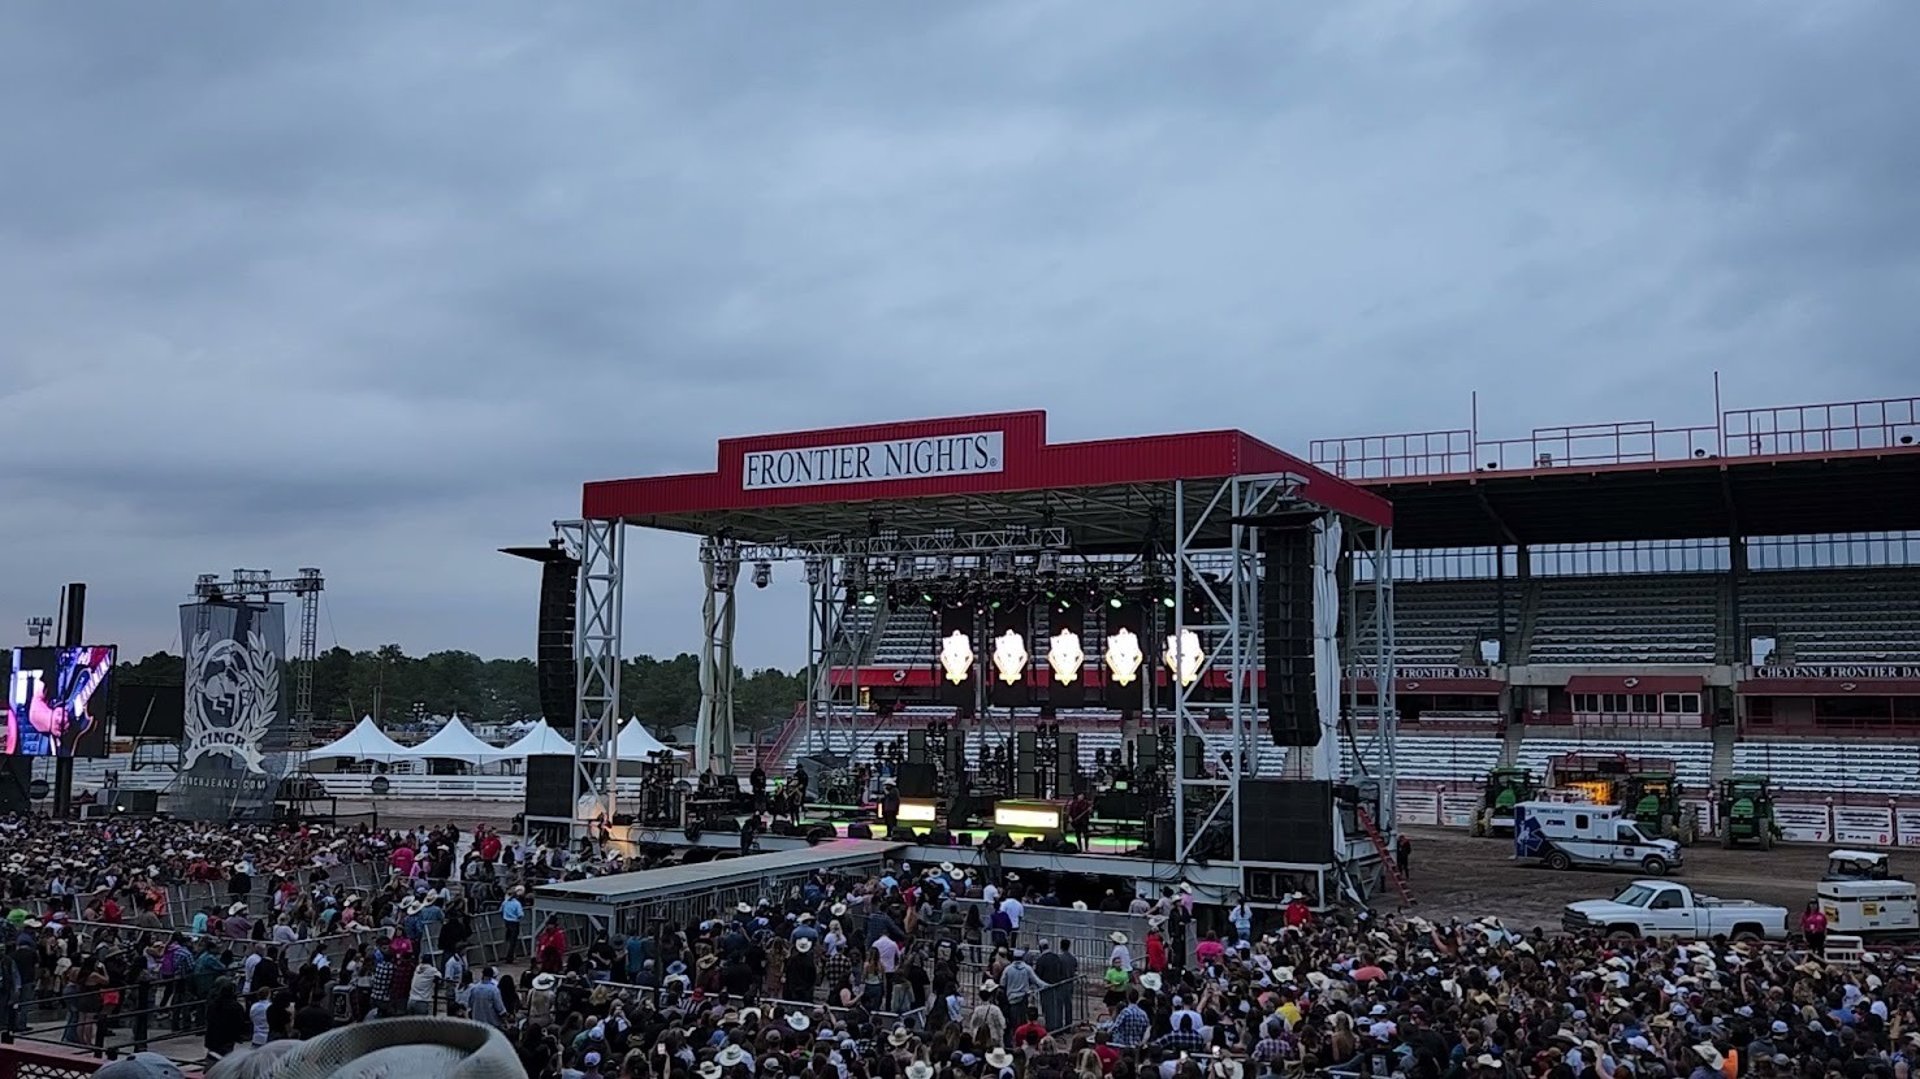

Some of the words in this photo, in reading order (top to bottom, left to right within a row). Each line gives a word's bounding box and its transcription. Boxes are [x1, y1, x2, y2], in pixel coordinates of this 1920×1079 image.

[747, 446, 873, 486] FRONTIER
[1403, 667, 1456, 678] FRONTIER
[1459, 668, 1486, 678] DAYS
[1758, 666, 1827, 678] CHEYENNE
[1831, 666, 1897, 678] FRONTIER
[200, 731, 245, 749] CINCH
[180, 775, 266, 790] CINCHJEANSCOM
